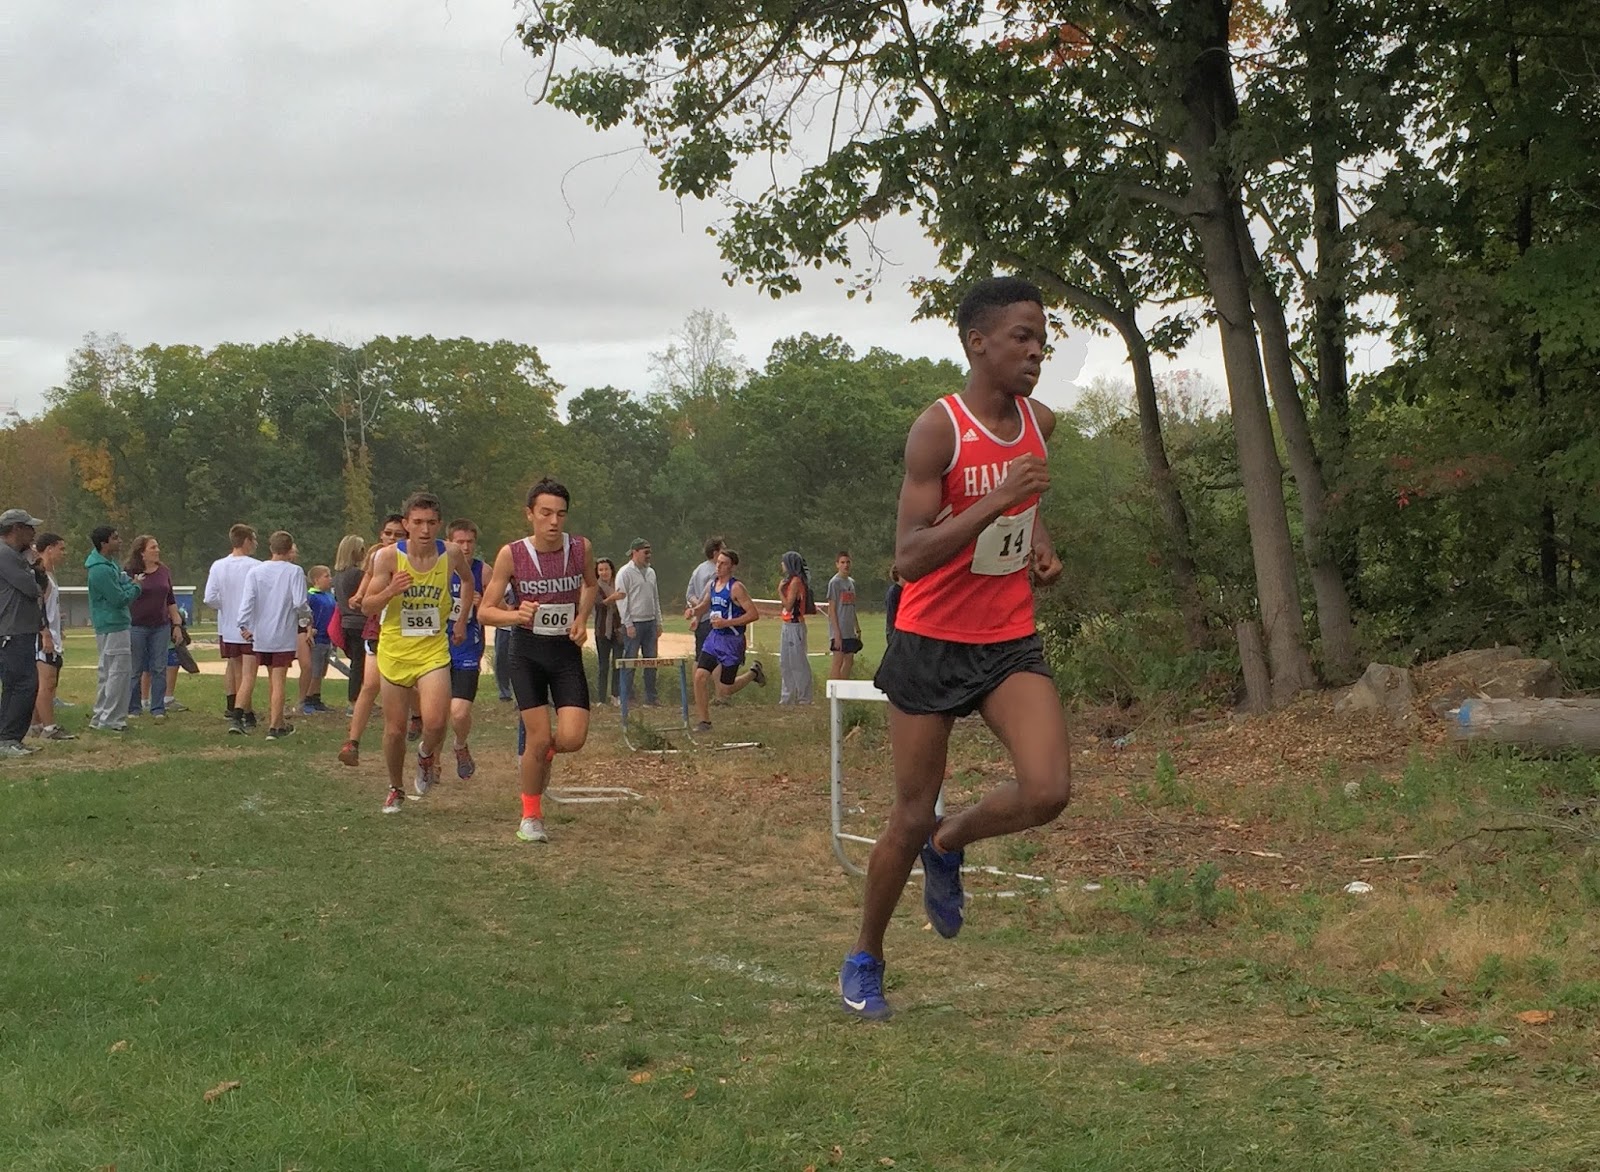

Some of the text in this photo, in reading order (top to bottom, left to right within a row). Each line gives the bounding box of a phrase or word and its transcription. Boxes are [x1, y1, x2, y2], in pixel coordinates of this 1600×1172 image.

[963, 461, 1012, 496] HAM
[999, 528, 1025, 557] 14
[403, 585, 443, 600] NORTH
[407, 616, 433, 627] 584
[541, 613, 569, 626] 606
